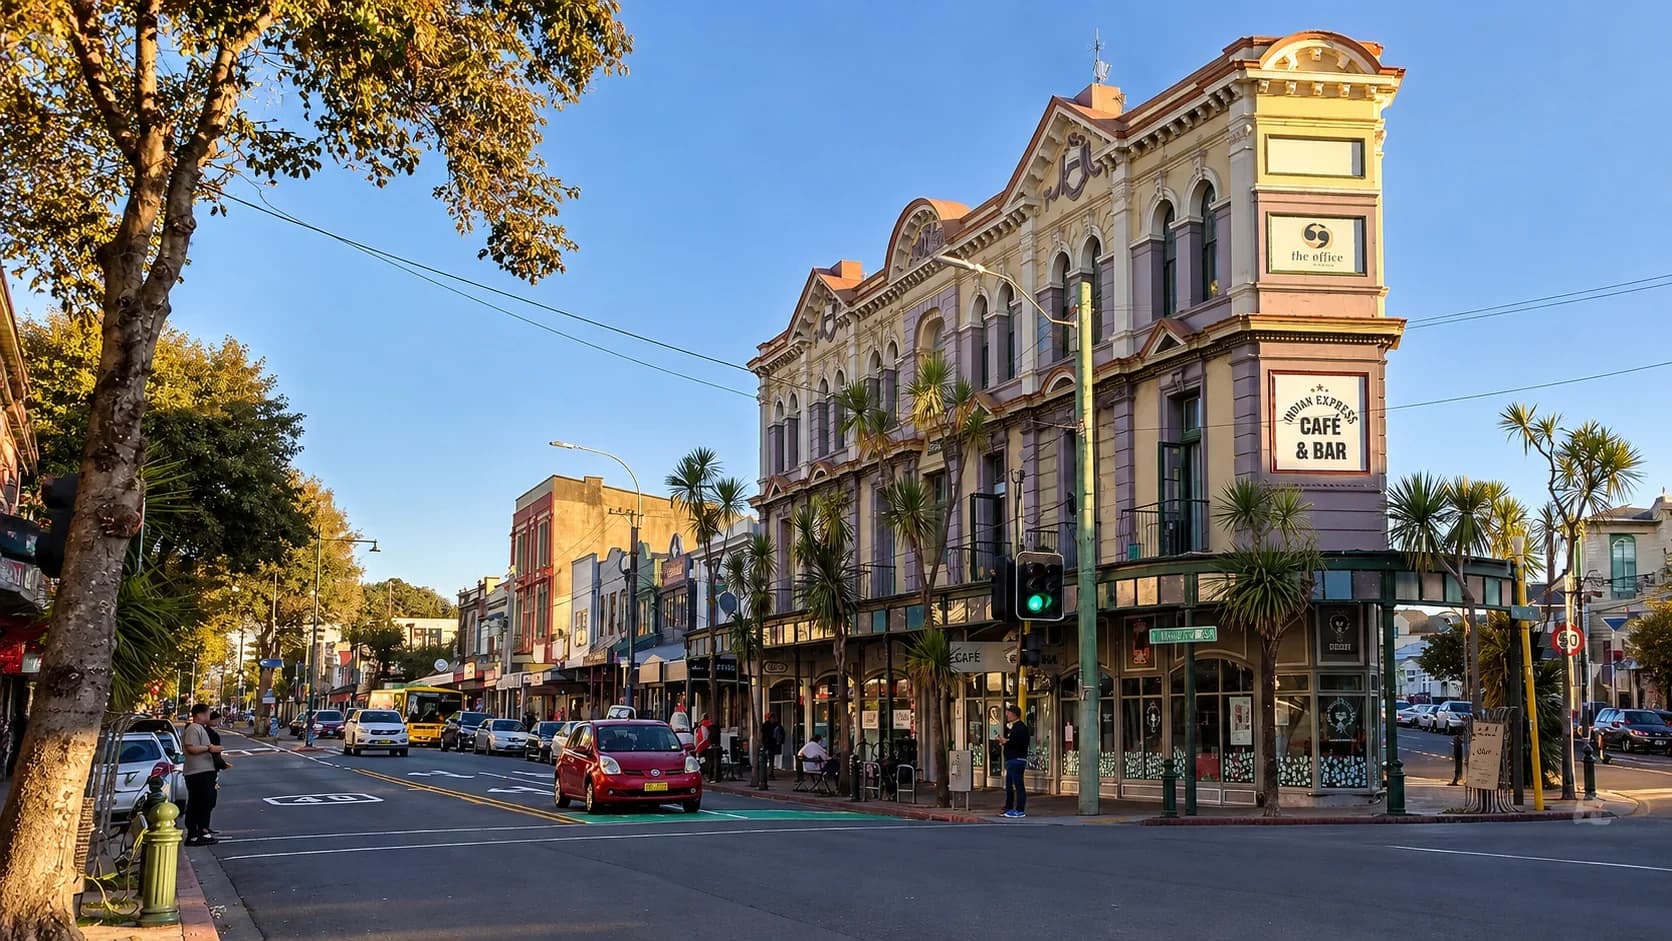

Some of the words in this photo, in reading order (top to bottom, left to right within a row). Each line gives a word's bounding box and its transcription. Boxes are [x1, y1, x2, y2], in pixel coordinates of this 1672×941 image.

[1291, 250, 1309, 261] the
[1312, 251, 1344, 262] office
[1284, 396, 1313, 424] INDIAN
[1316, 395, 1358, 424] EXPRESS
[1300, 413, 1341, 435] CAFÉ
[1296, 442, 1308, 459] &
[1313, 442, 1346, 460] BAR
